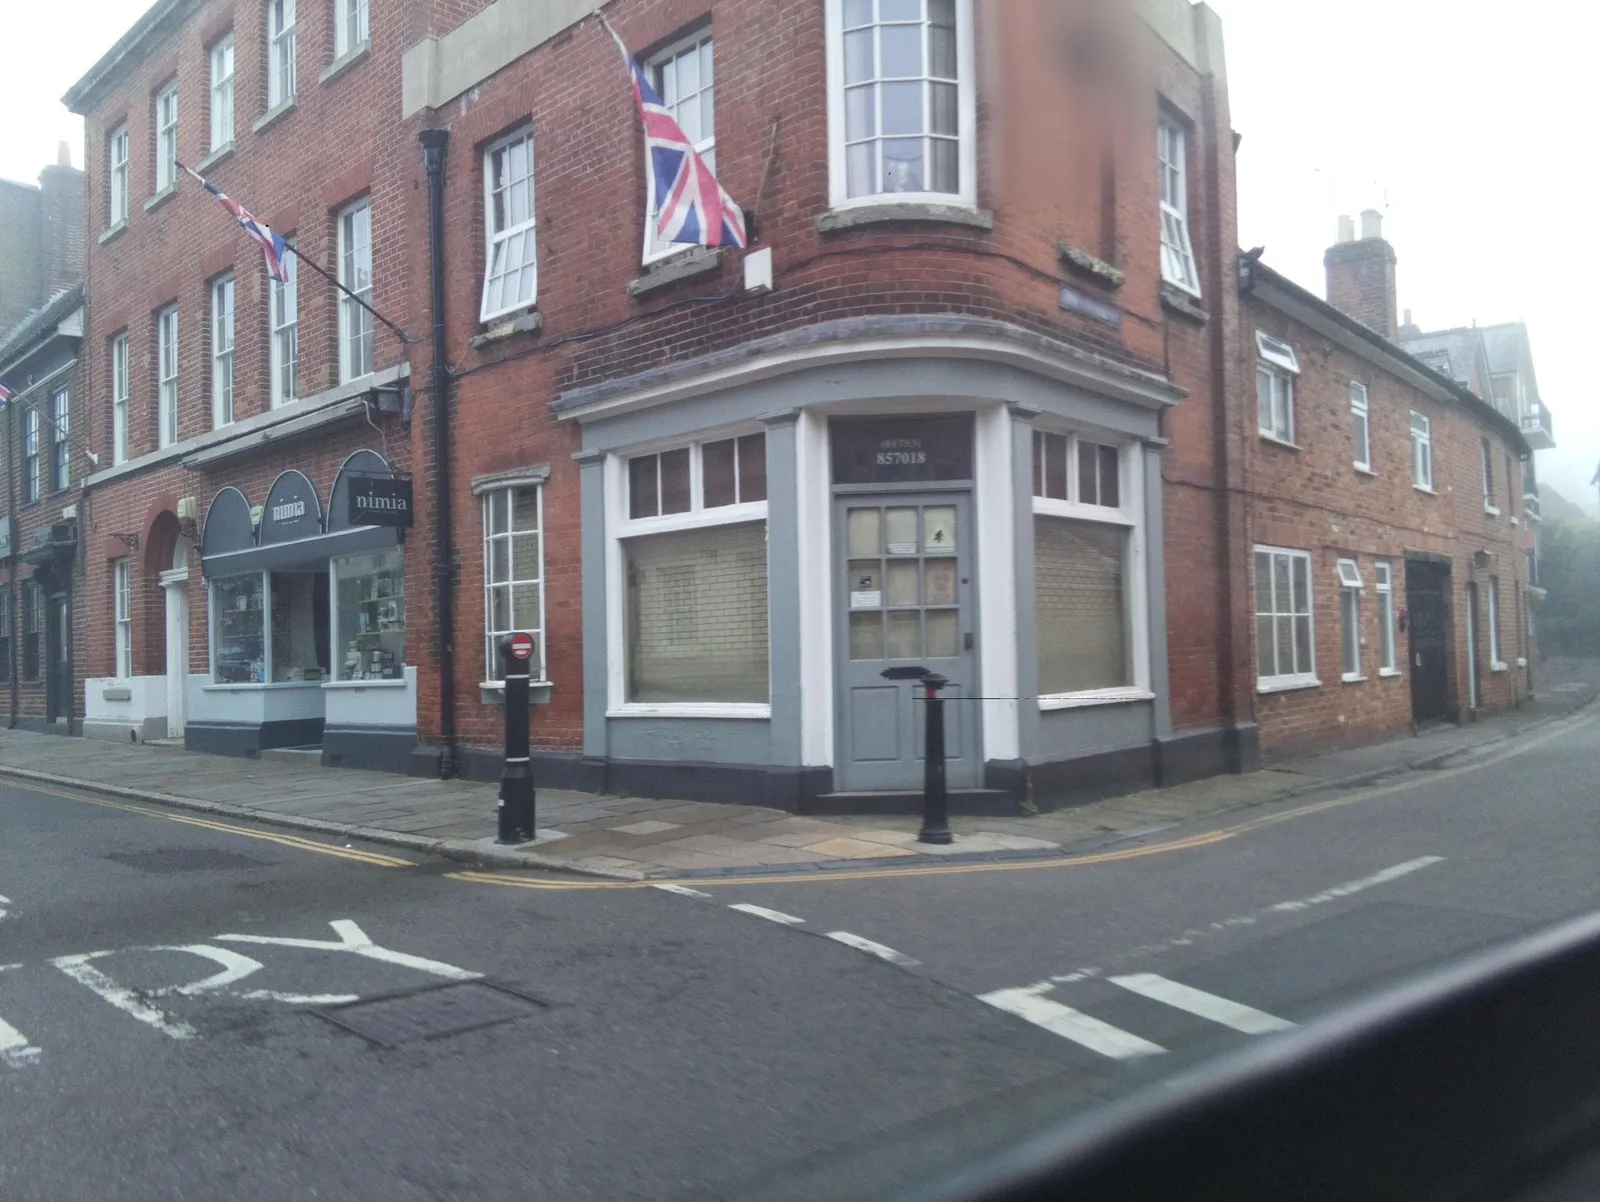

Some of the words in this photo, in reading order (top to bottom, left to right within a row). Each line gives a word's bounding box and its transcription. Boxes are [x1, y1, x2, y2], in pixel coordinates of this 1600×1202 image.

[876, 451, 927, 465] 857018
[272, 495, 305, 521] nimia
[356, 491, 407, 510] nimia
